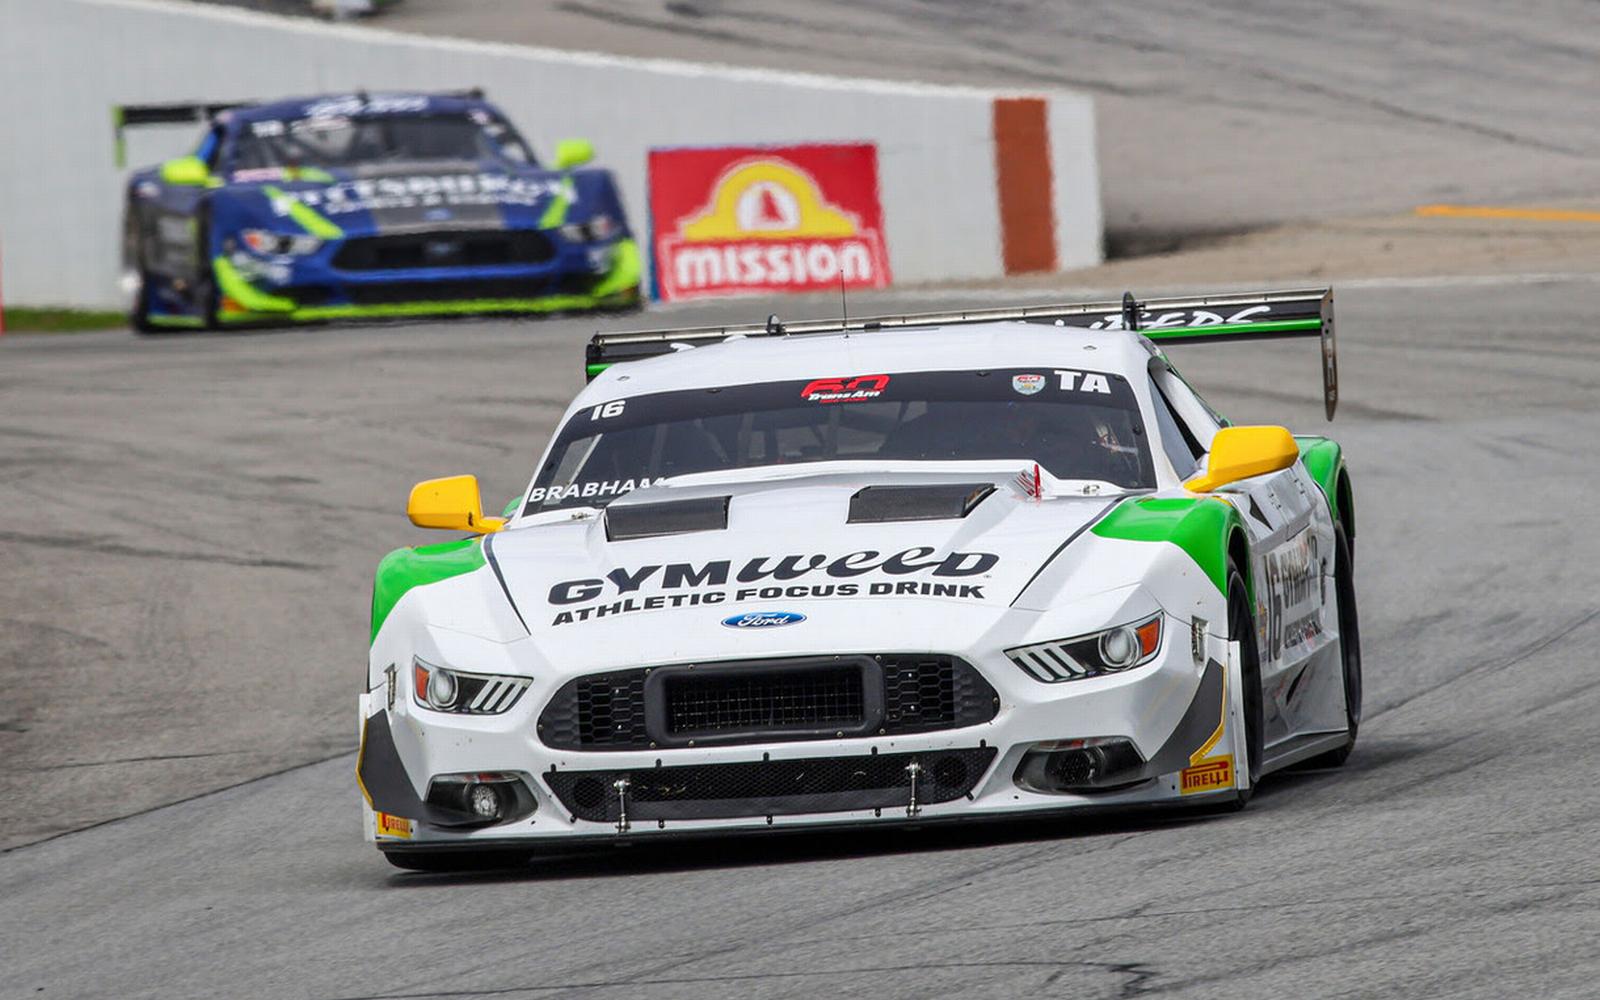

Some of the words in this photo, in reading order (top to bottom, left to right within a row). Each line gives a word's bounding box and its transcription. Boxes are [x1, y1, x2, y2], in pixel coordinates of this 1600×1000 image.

[800, 374, 890, 397] 60
[1053, 370, 1112, 394] TA
[590, 400, 626, 422] 16
[551, 591, 726, 627] ATHLETIC
[735, 583, 859, 602] FOCUS
[869, 581, 986, 599] DRINK
[737, 612, 791, 627] Ford
[1182, 761, 1229, 789] PIRELLI
